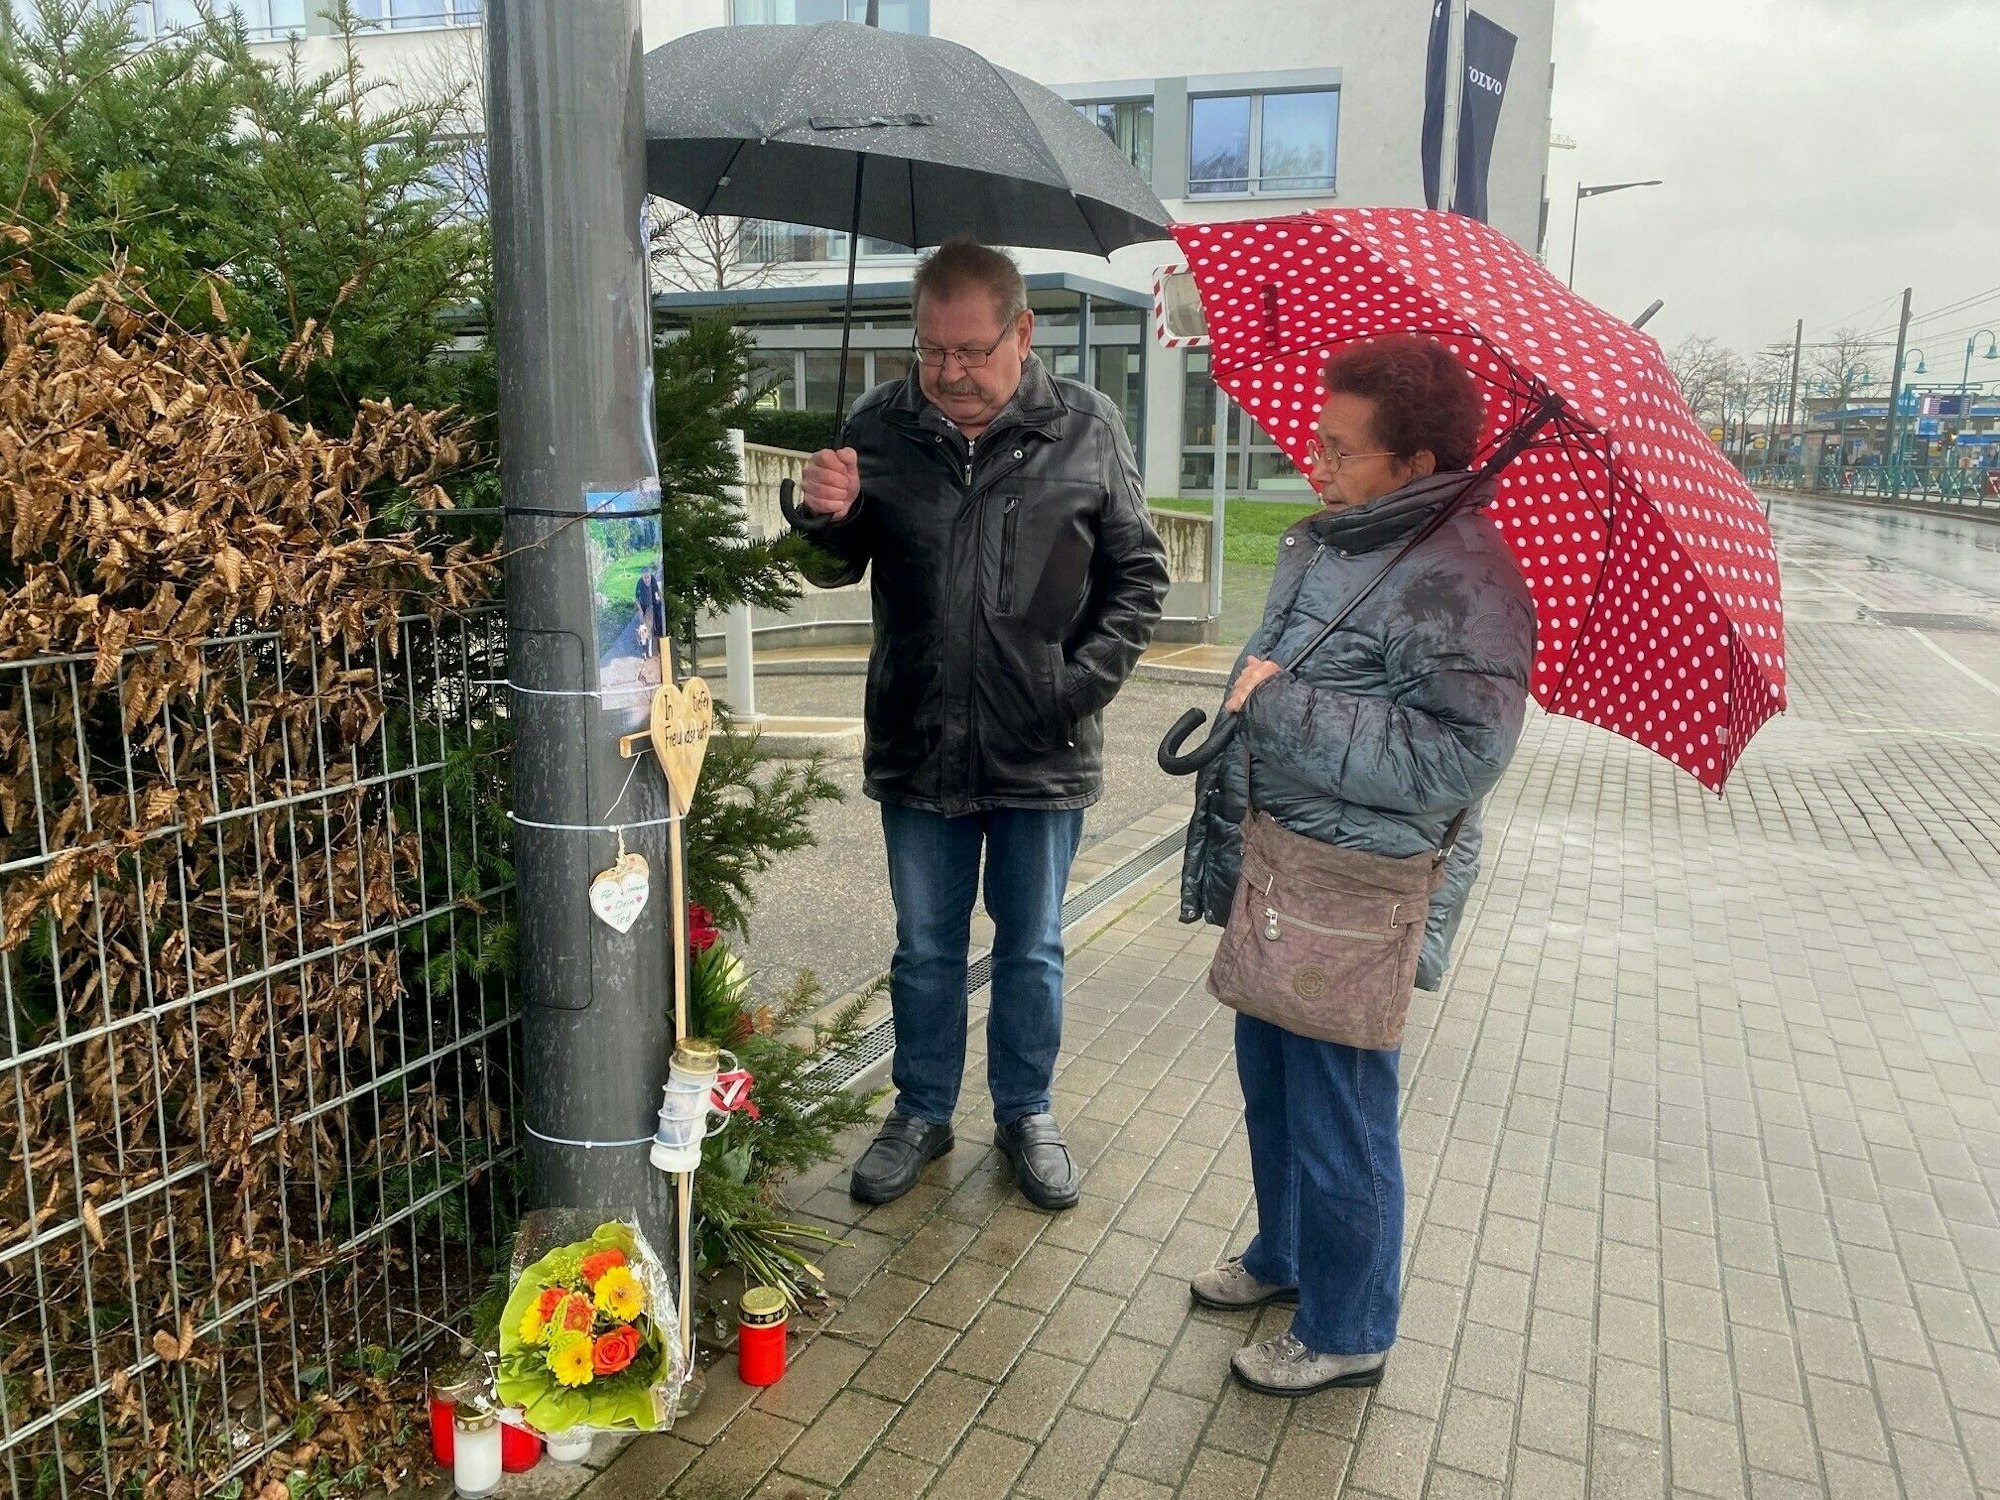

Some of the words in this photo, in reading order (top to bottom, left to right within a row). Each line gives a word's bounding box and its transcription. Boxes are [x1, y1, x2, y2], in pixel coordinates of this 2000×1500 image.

[1468, 65, 1502, 95] OLVO
[664, 694, 674, 721] In
[665, 719, 708, 750] Freudscaft
